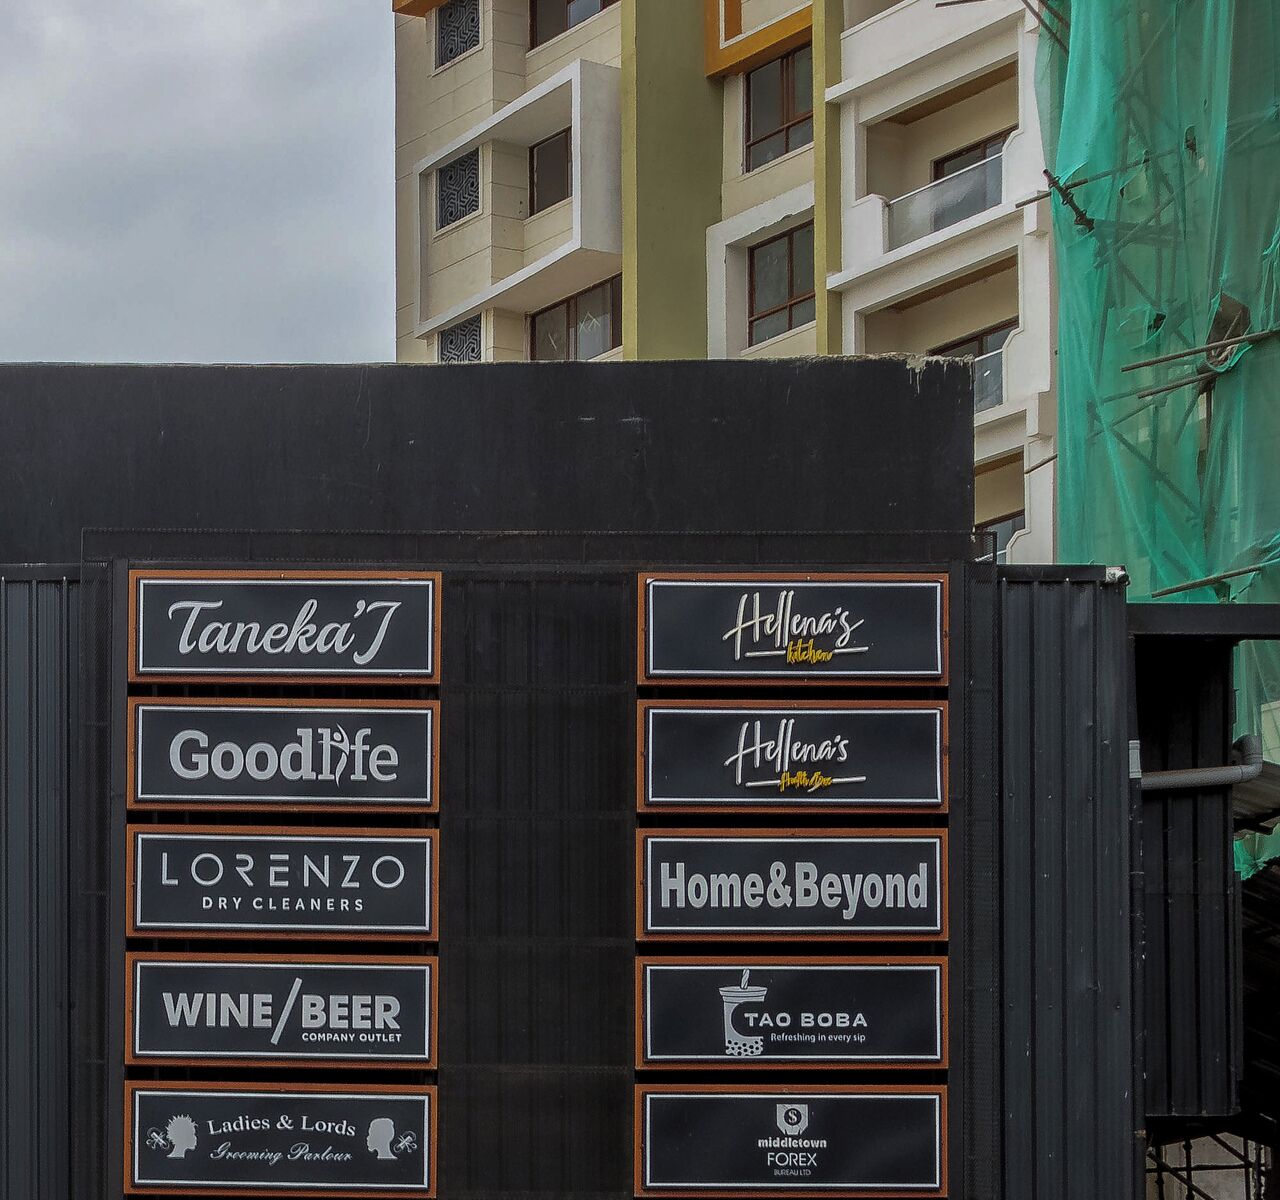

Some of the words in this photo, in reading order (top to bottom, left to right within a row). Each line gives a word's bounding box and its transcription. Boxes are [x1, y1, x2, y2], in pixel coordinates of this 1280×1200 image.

[722, 590, 864, 660] Hellena's
[724, 718, 848, 786] Hellena's
[161, 852, 405, 889] LORENZO
[659, 861, 928, 920] Home&Beyond
[202, 896, 251, 910] DRY
[253, 897, 364, 912] CLEANERS
[162, 977, 401, 1046] WINE/BEER
[744, 1013, 790, 1027] TAO
[801, 1013, 868, 1028] BOBA
[301, 1032, 355, 1043] COMPANY
[359, 1033, 402, 1043] OUTLET
[770, 1033, 816, 1043] Refreshing
[818, 1033, 826, 1042] in
[828, 1035, 851, 1044] every
[853, 1033, 866, 1043] sip
[206, 1114, 270, 1135] Ladies
[276, 1114, 294, 1130] &
[301, 1116, 356, 1136] Lords
[758, 1137, 827, 1148] middletown
[210, 1142, 283, 1166] Grooming
[287, 1142, 353, 1162] Parlour
[767, 1153, 817, 1166] FOREX
